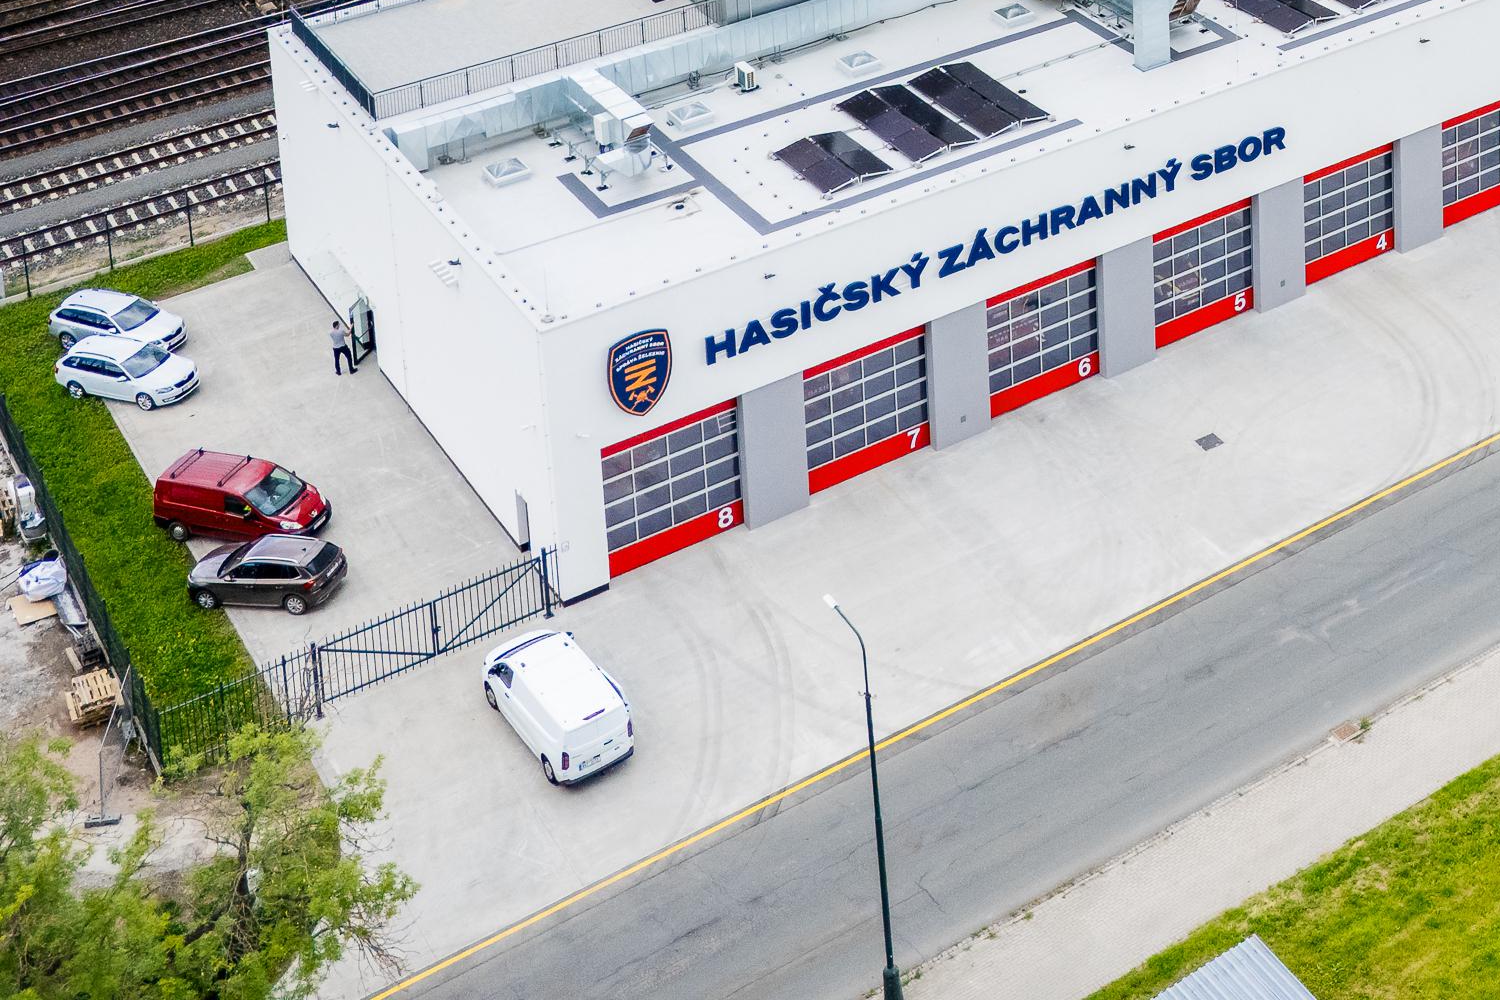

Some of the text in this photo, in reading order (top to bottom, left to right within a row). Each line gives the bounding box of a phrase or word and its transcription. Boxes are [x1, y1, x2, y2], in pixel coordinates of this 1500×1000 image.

[705, 126, 1287, 367] HASIČSKÝ ZÁCHRANNÝ SBOR
[1375, 233, 1388, 251] 4
[1234, 291, 1247, 312] 5
[1077, 357, 1092, 378] 6
[907, 427, 921, 449] 7
[718, 506, 734, 529] 8
